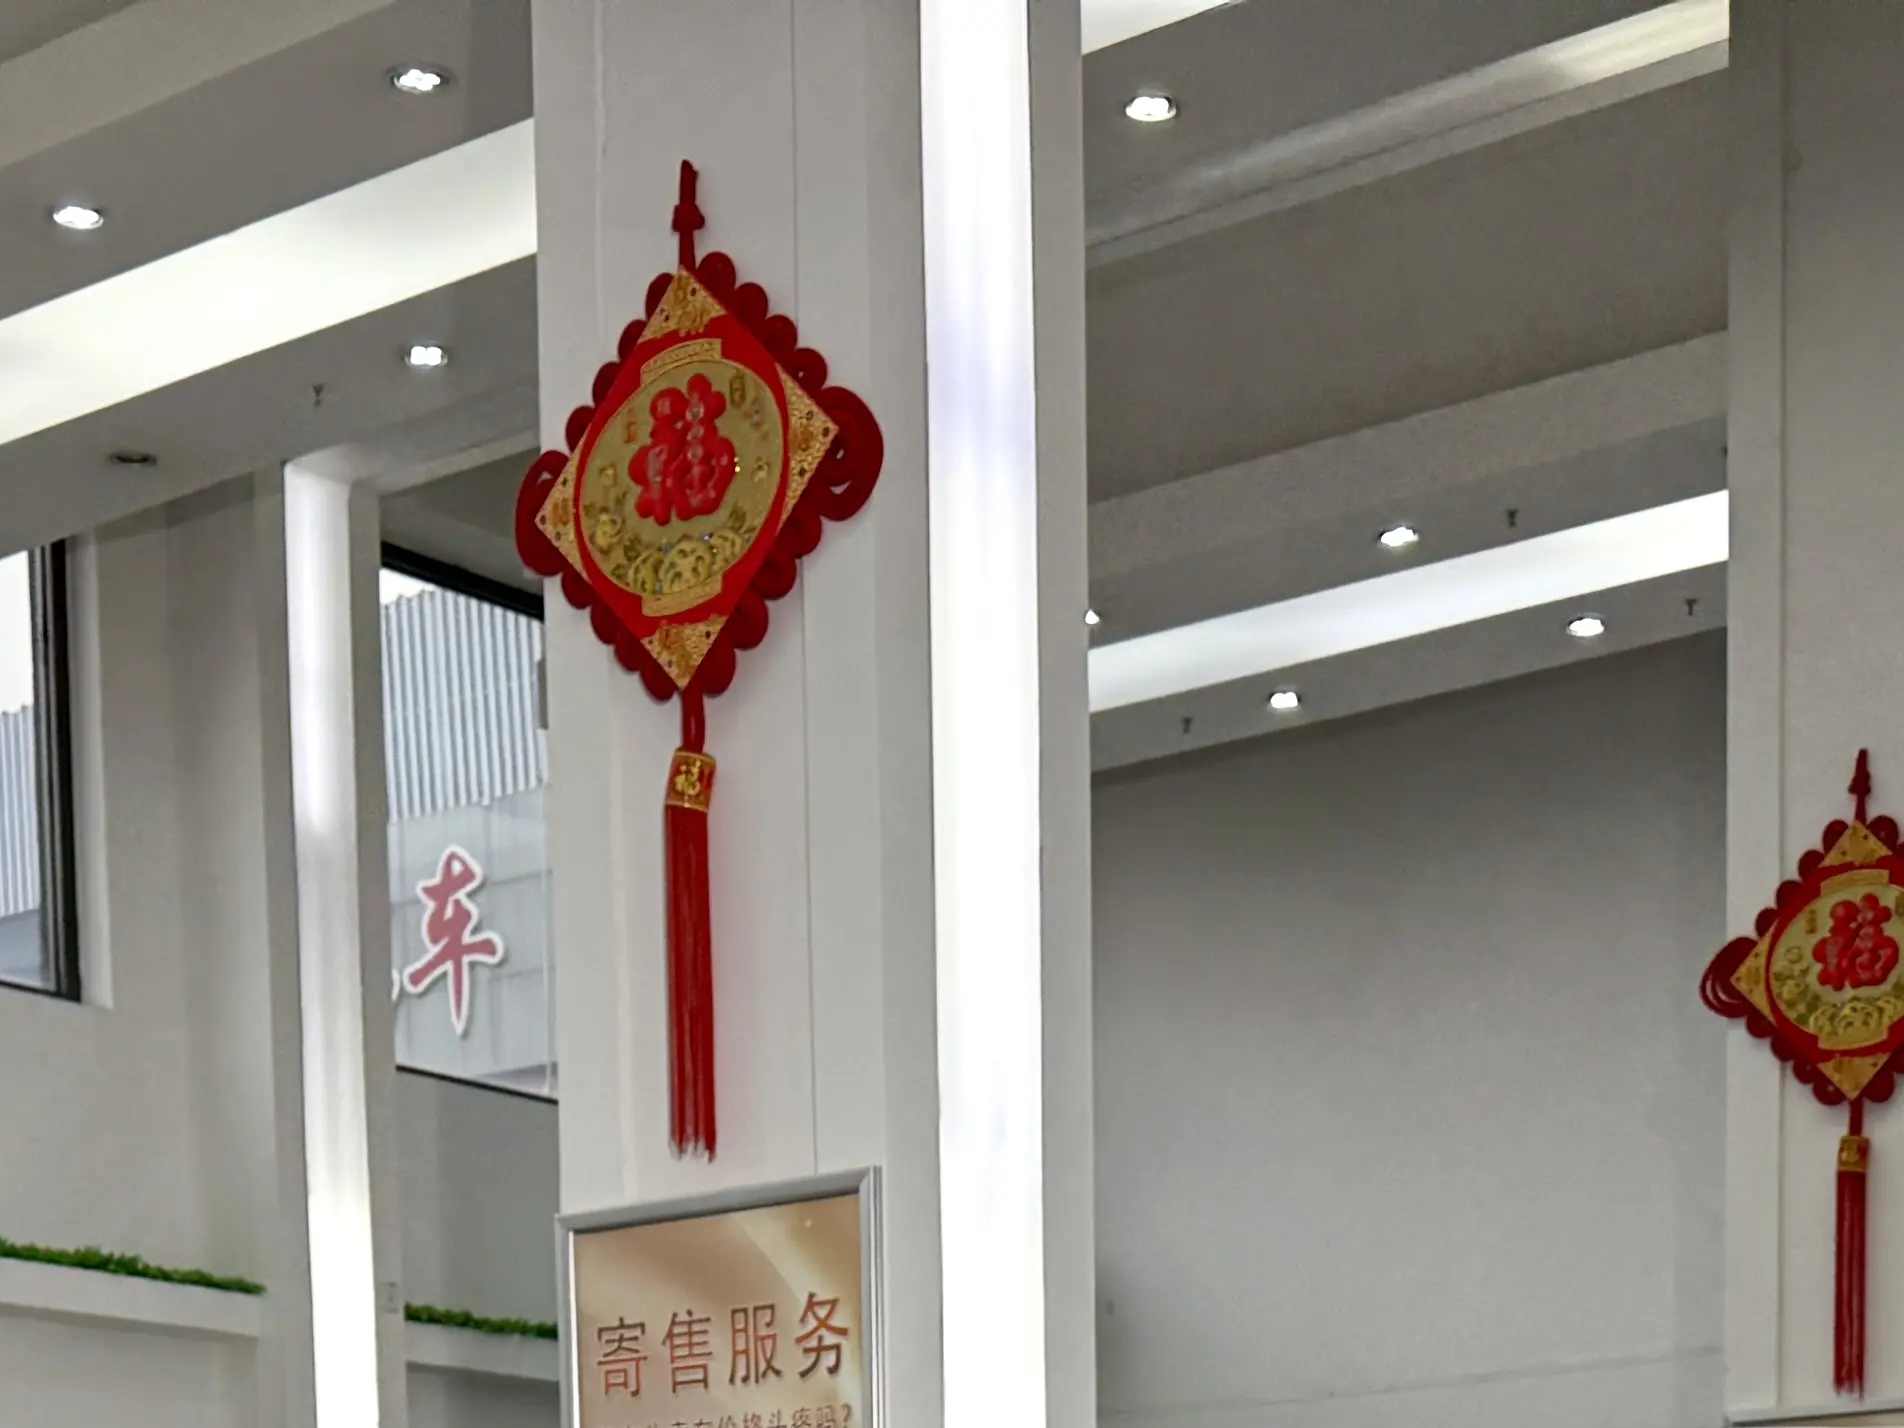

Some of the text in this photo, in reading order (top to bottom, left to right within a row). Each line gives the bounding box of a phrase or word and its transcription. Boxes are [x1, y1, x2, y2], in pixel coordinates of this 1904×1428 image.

[628, 373, 737, 527] 福
[1812, 892, 1900, 992] 福
[596, 1291, 850, 1399] 寄售服务
